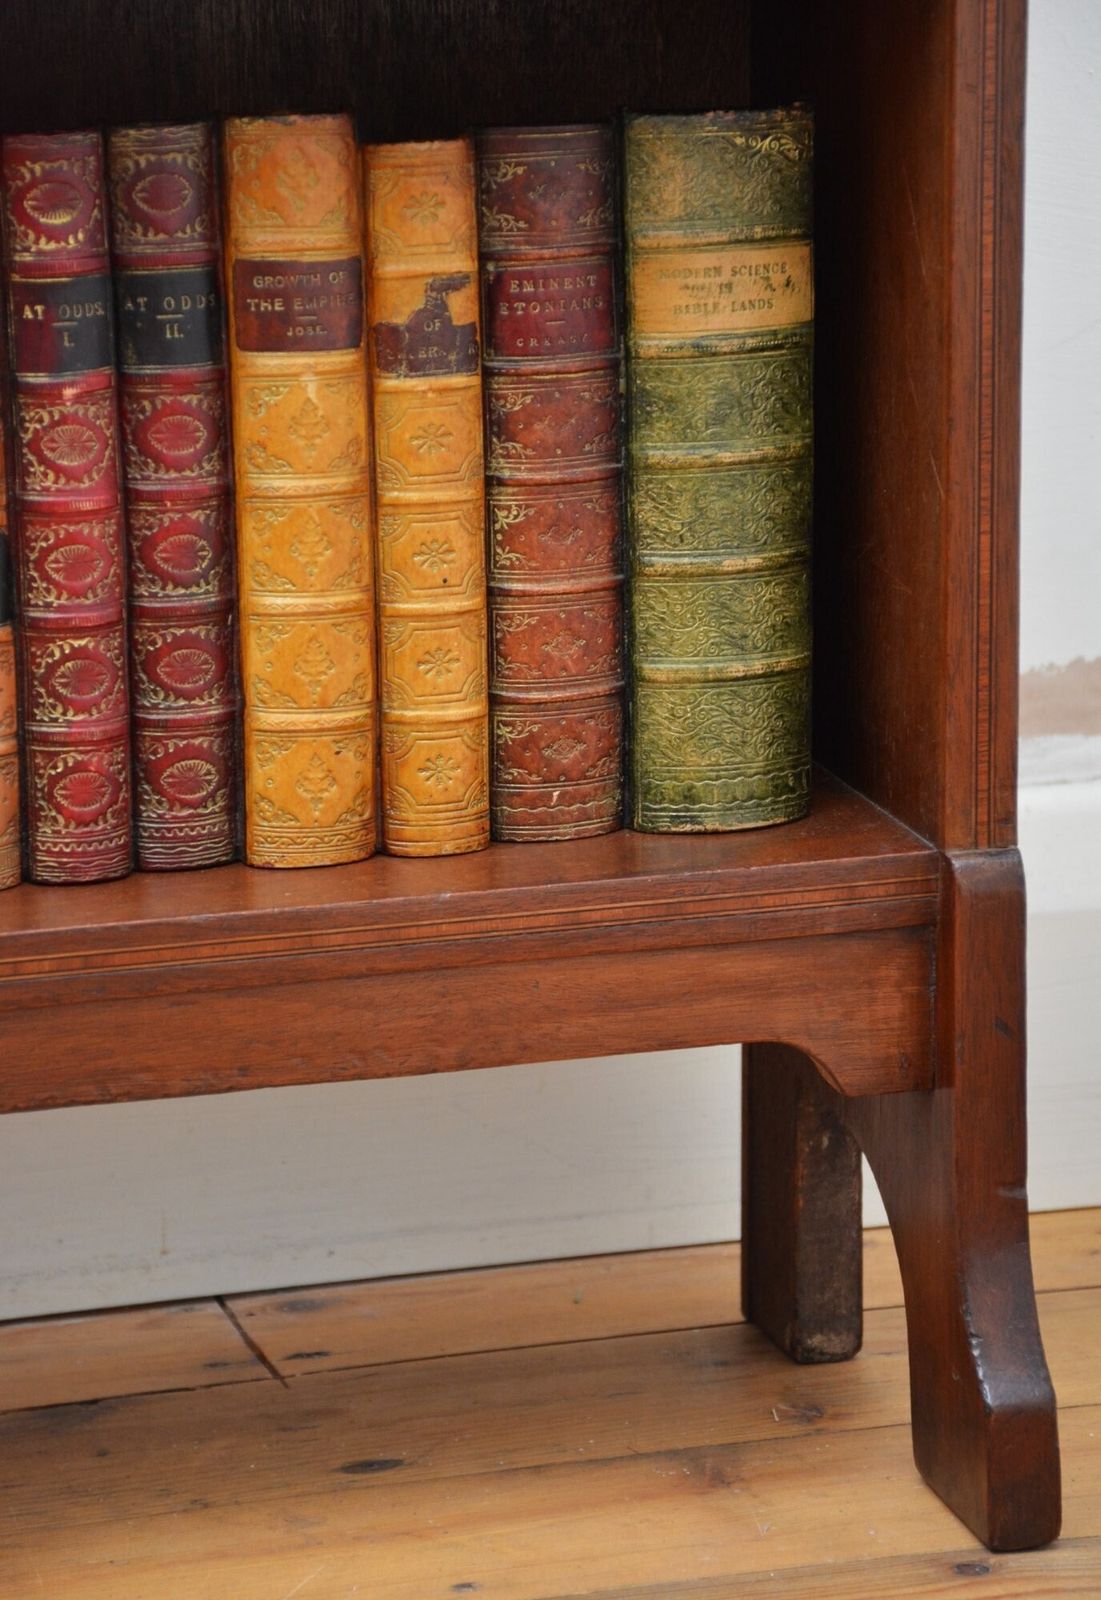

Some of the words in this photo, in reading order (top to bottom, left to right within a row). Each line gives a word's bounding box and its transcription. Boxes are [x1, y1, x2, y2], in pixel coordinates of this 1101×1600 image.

[657, 266, 723, 280] MODERN
[730, 262, 788, 277] SCIENCE
[252, 273, 321, 289] GROWTH
[510, 275, 597, 293] EMINENT
[124, 297, 148, 312] AT
[163, 293, 216, 311] ODDS
[246, 298, 285, 312] THE
[499, 296, 604, 315] ETONIANS
[672, 302, 721, 316] BIBLE
[731, 298, 774, 313] LANDS
[23, 304, 45, 320] AT
[423, 319, 441, 332] OF
